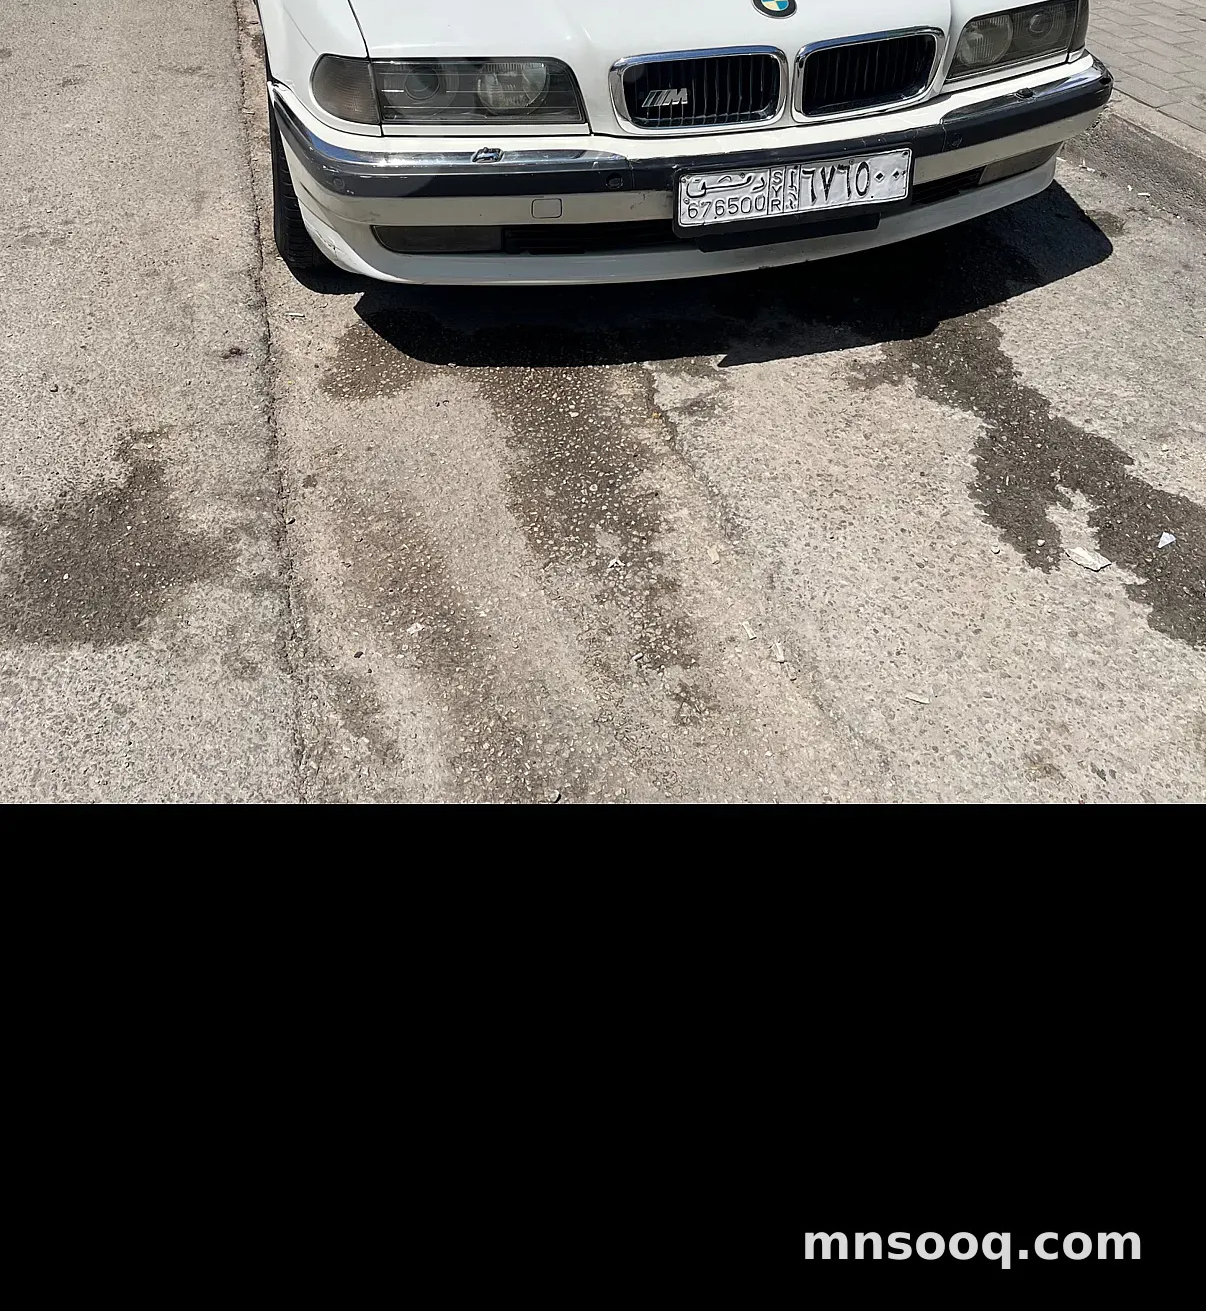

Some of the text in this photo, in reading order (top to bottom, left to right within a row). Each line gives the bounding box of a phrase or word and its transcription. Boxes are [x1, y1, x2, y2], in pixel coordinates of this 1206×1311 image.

[770, 170, 783, 212] SYR
[801, 161, 900, 204] ٦٧٦٥٠٠
[687, 193, 766, 219] 676500
